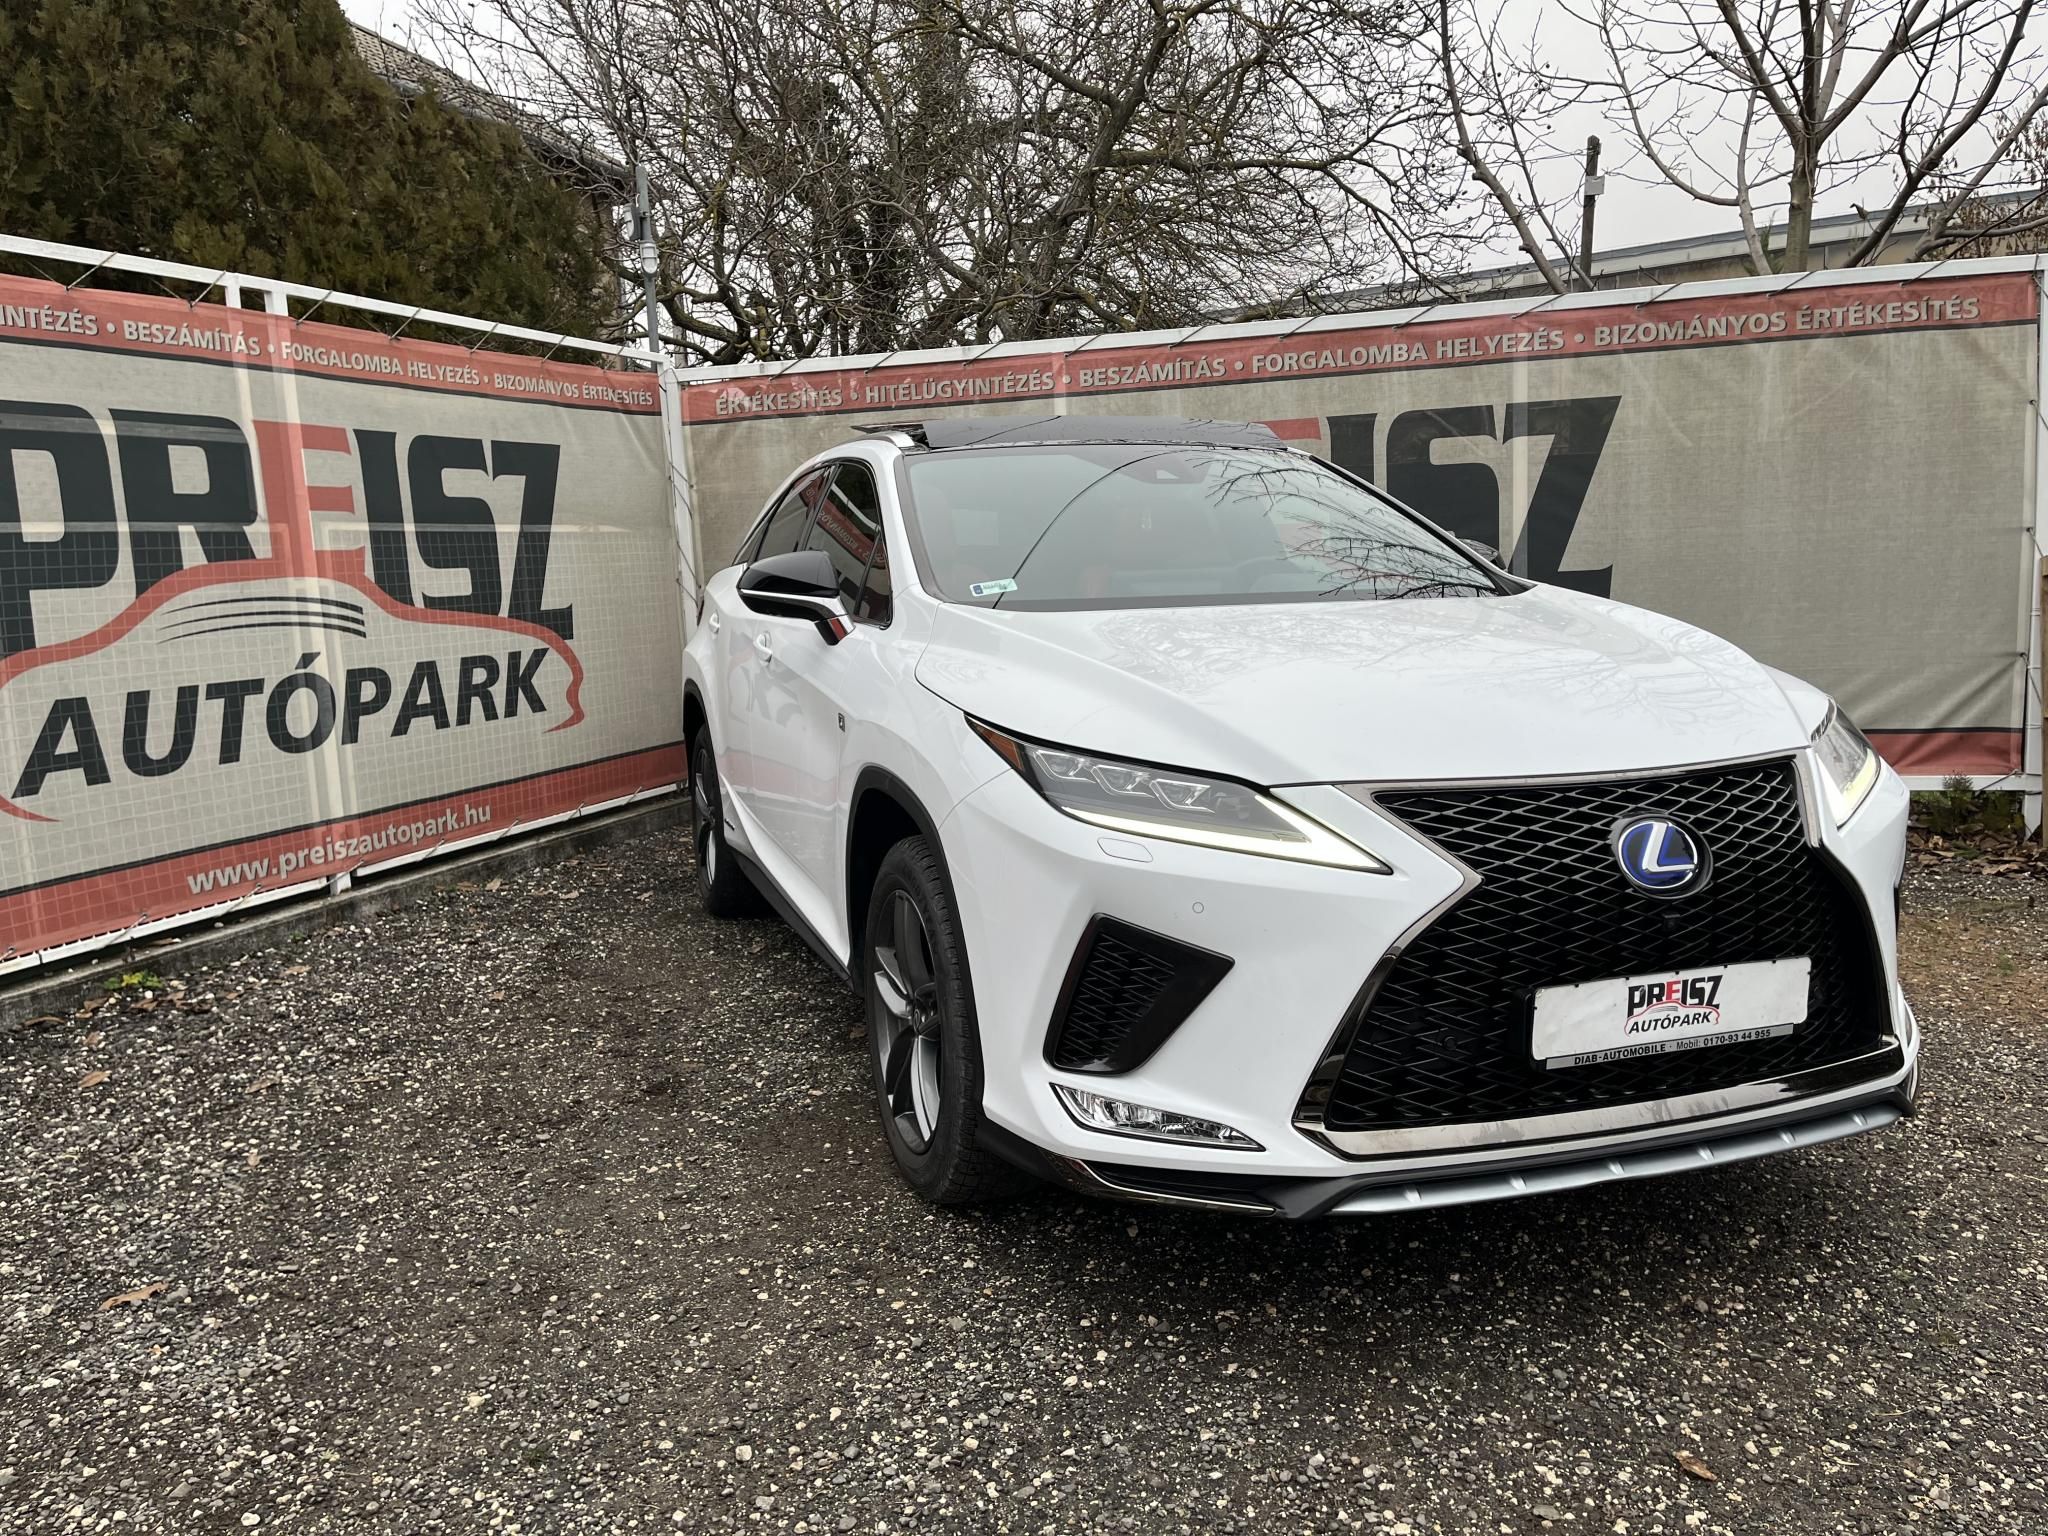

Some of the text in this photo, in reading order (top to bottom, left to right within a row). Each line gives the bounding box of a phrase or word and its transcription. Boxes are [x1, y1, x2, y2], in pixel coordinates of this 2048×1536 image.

[123, 320, 261, 356] BESZÁMÍTÁS
[281, 341, 404, 376] FORGALOMBA
[407, 361, 480, 386] HELYEZÉS
[494, 373, 579, 399] BIZOMÁNYOS
[715, 387, 843, 416] ÉRTÉKESÍTÉS
[1079, 356, 1226, 388] BESZÁMÍTÁS
[1252, 343, 1429, 375] FORGALOMBA
[1436, 329, 1565, 360] HELYEZÉS
[1594, 311, 1787, 347] BIZOMÁNYOS
[1796, 297, 1980, 331] ÉRTÉKESÍTÉS
[0, 399, 574, 656] PREISZ
[11, 646, 550, 799] AUTÓPARK
[187, 801, 491, 895] www.preiszautopark.hu
[1627, 975, 1723, 1019] PREISZ
[1628, 1011, 1712, 1034] AUTÓPARK
[1574, 1043, 1667, 1066] DIAB-AUTOMOBILE
[1703, 1033, 1739, 1047] 0170-93
[1741, 1031, 1752, 1041] 44
[1754, 1028, 1771, 1039] 955
